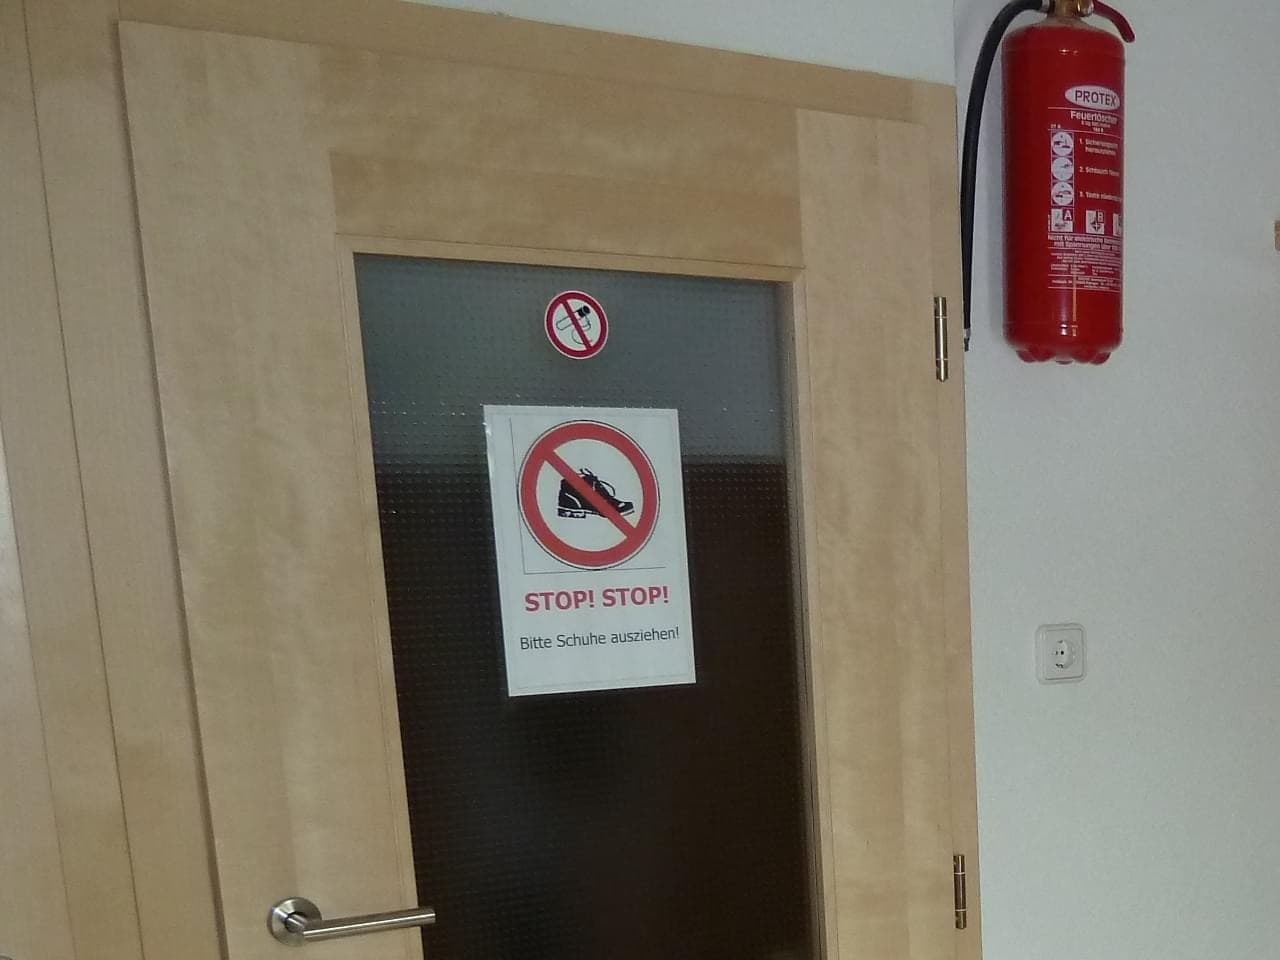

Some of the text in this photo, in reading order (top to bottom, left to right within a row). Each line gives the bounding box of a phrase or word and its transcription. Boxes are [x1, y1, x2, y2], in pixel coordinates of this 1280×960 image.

[1075, 90, 1116, 107] PROTEX
[1070, 110, 1118, 124] Feuerlöscher
[1064, 209, 1072, 220] A
[525, 586, 669, 612] STOP! STOP!
[520, 627, 680, 650] Bitte Schuhe ausziehen!
